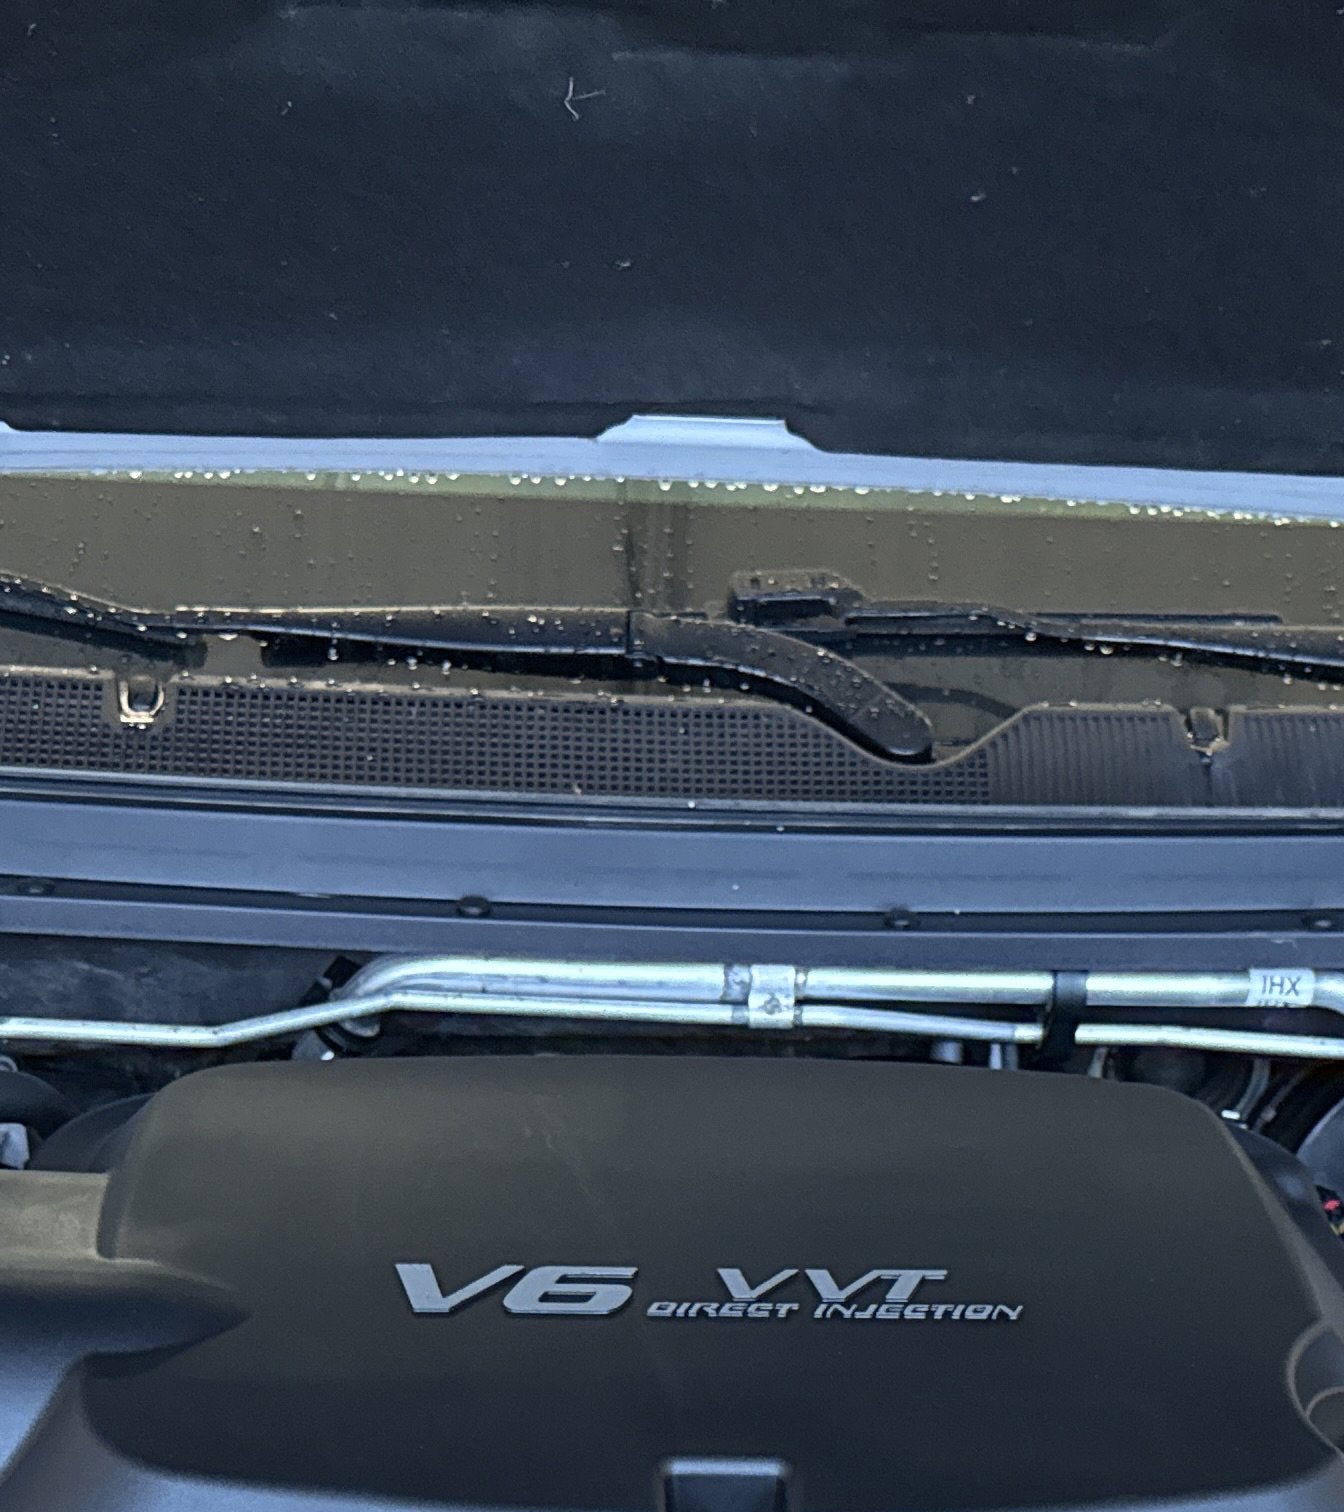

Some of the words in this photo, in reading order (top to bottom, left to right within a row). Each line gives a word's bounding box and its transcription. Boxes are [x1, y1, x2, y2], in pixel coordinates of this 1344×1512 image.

[394, 1263, 639, 1315] V6
[716, 1268, 948, 1302] VVT
[646, 1302, 800, 1318] DIRECT
[812, 1303, 1024, 1320] INJECTION
